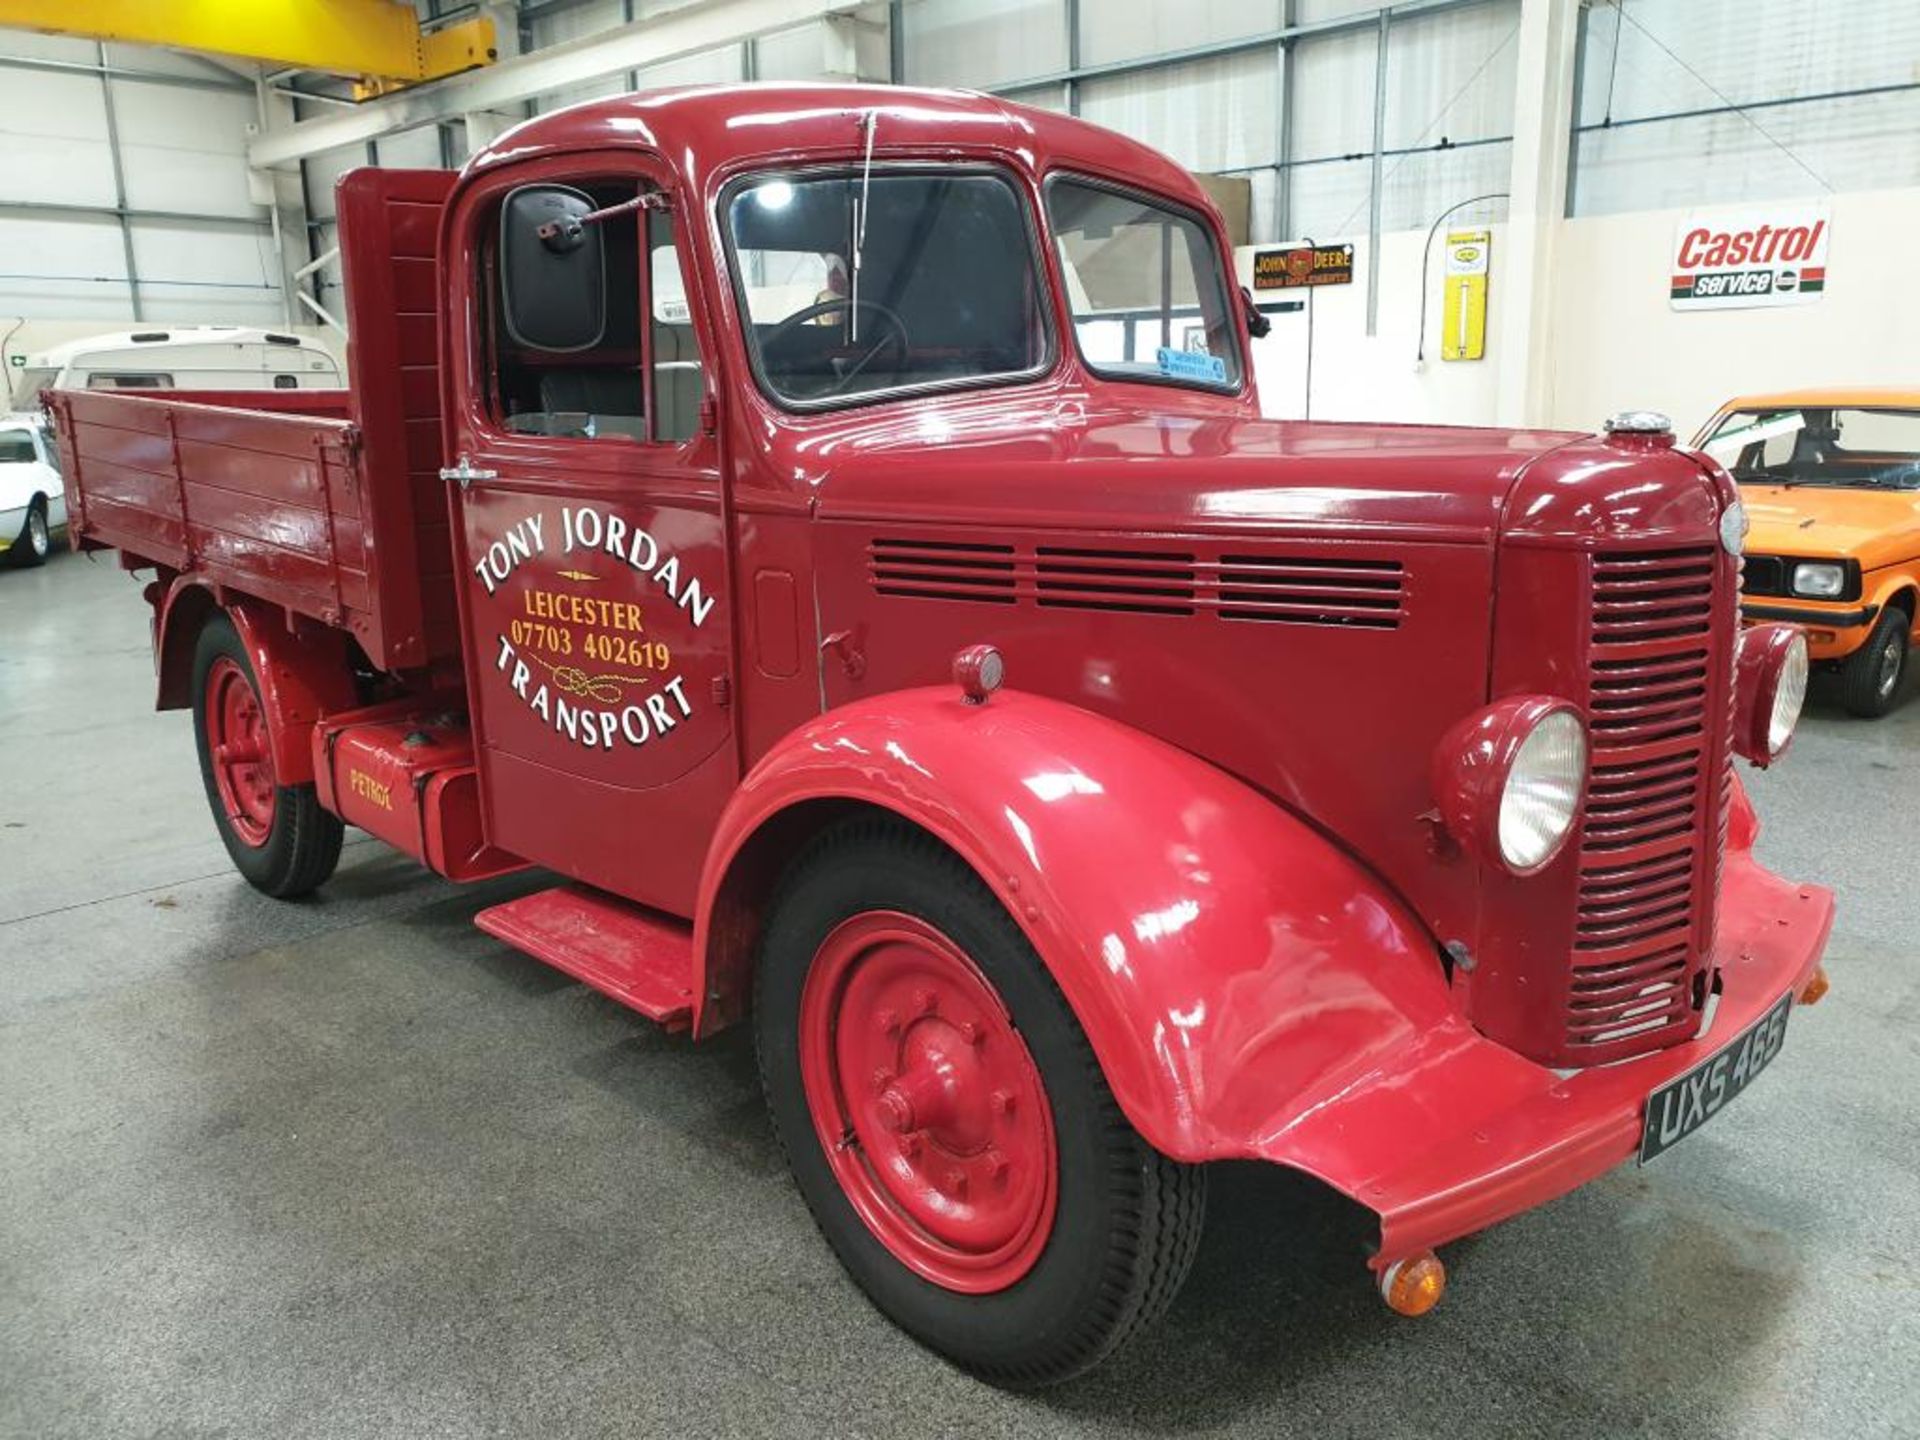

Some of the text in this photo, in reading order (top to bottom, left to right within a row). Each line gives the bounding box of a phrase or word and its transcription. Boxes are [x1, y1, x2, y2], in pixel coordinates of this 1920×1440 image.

[1256, 251, 1351, 273] JOHN DEERE
[1678, 220, 1825, 269] Castrol
[1695, 272, 1771, 295] service
[475, 507, 715, 628] TONY JORDAN
[524, 589, 644, 633] LEICESTER
[511, 620, 670, 671] 07703 402619
[497, 636, 692, 749] TRANSPORT
[351, 769, 393, 811] PETROL
[1659, 1006, 1786, 1146] UXS 465
